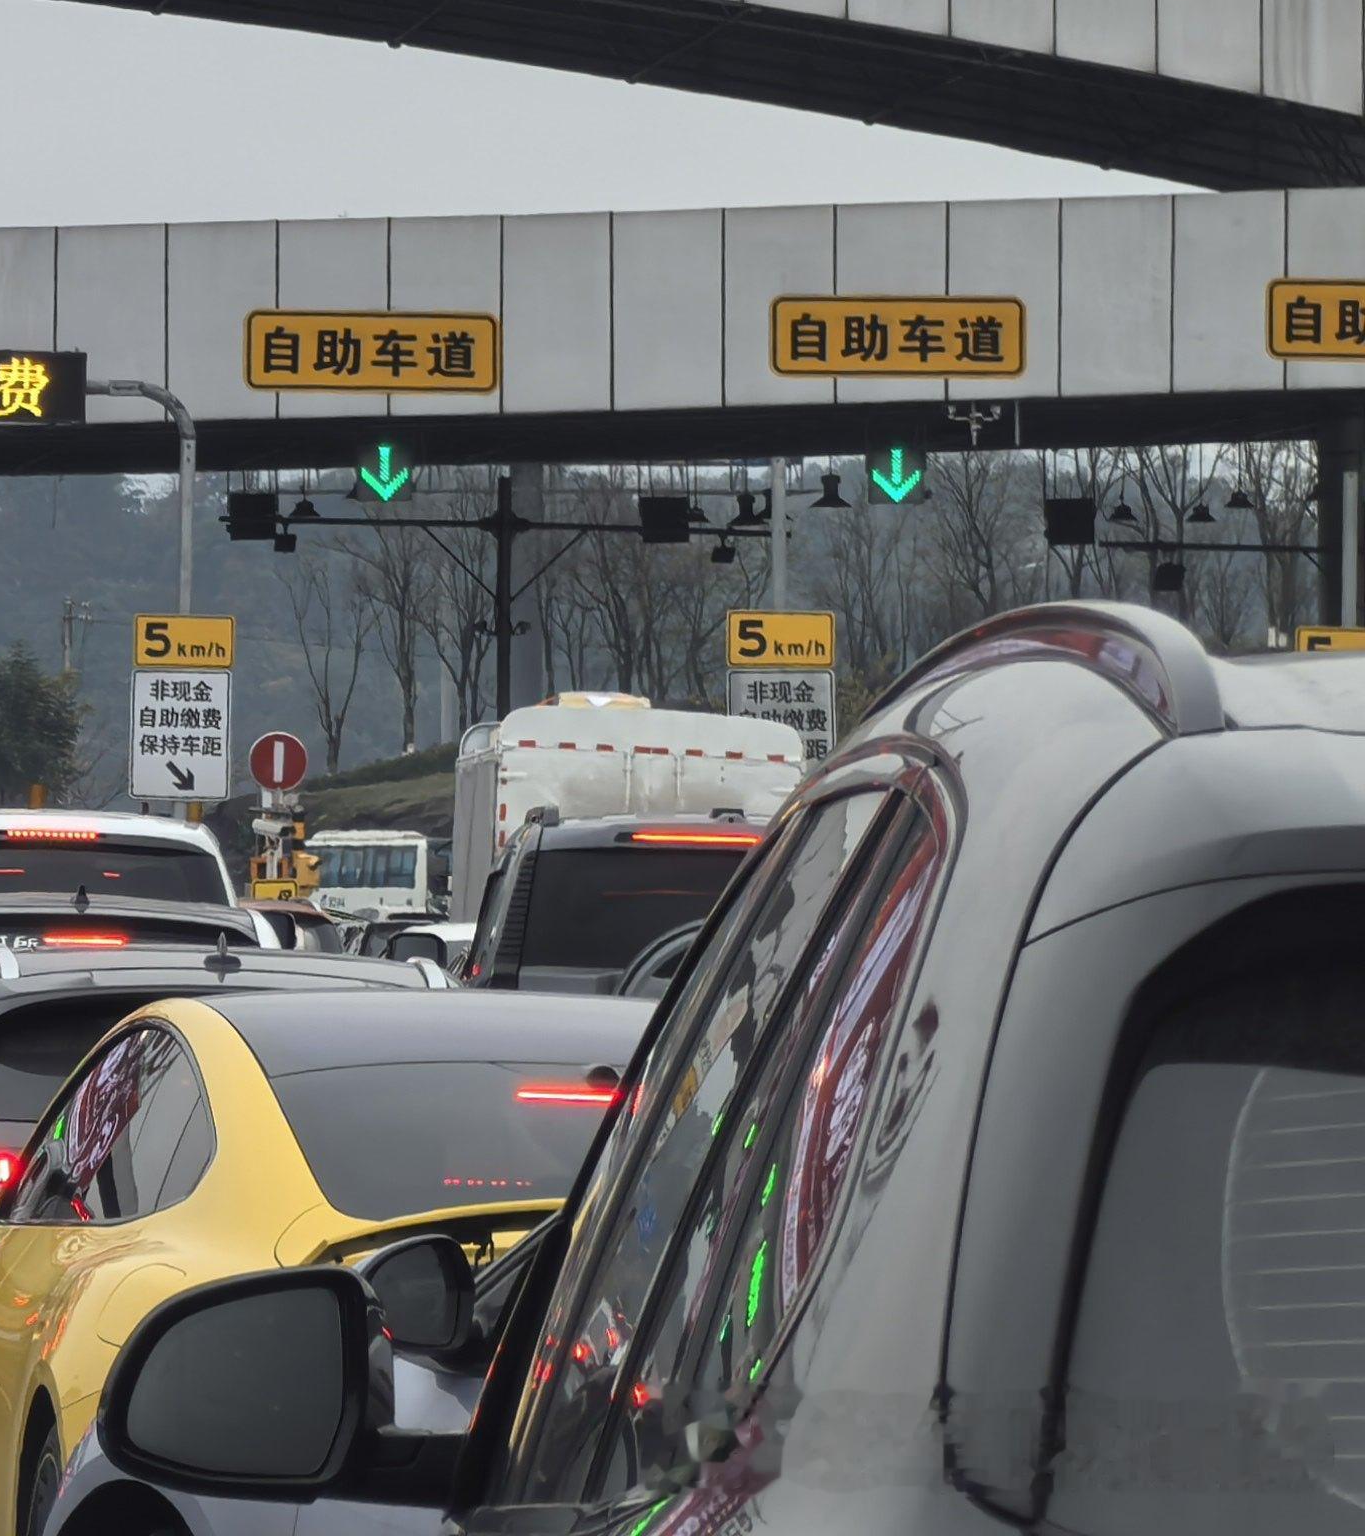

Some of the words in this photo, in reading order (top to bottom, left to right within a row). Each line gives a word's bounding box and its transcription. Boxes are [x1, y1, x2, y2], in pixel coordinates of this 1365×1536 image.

[789, 314, 1005, 364] 自助车道
[262, 326, 477, 378] 自助车道
[149, 679, 213, 703] 非现金
[746, 679, 815, 705] 非现金
[139, 705, 222, 730] 自助缴费
[139, 734, 222, 757] 保持车距
